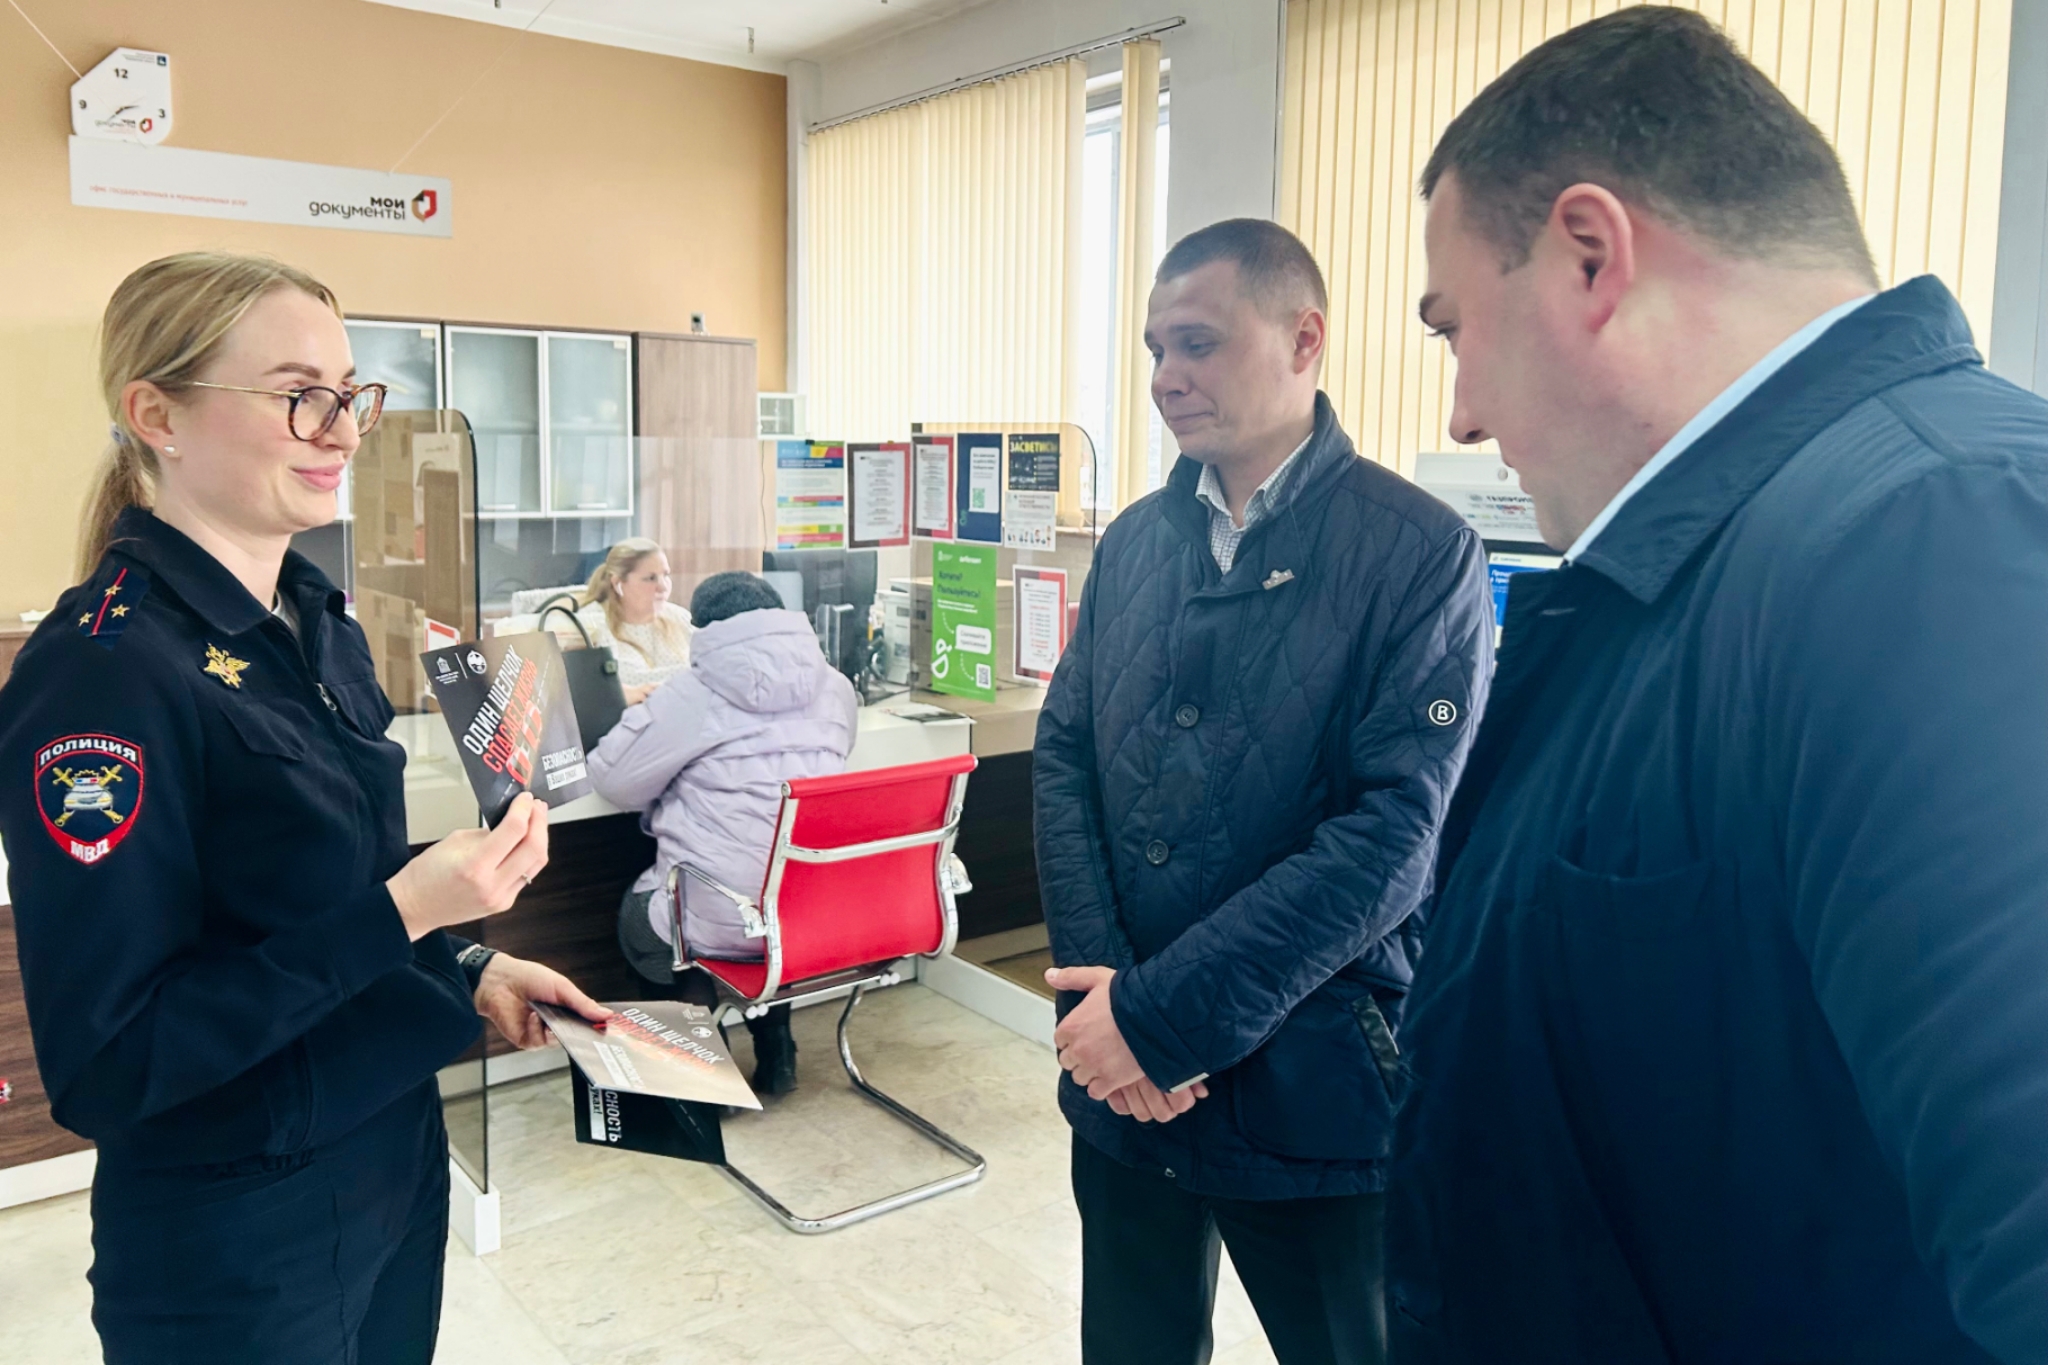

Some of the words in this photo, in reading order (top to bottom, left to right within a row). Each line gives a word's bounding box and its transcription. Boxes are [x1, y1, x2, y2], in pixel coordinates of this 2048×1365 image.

[114, 68, 128, 79] 12
[79, 99, 87, 109] 9
[158, 108, 166, 118] 3
[309, 201, 405, 220] документы
[370, 197, 405, 209] мои
[462, 701, 502, 755] ОДИН
[487, 644, 523, 712] ЩЕЛЧОК
[482, 699, 525, 774] СПАСАЕТ
[513, 657, 538, 707] ЖИЗНЬ
[1437, 705, 1449, 720] B
[40, 739, 137, 766] ПОЛИЦИЯ
[70, 838, 110, 862] МВД
[622, 1007, 667, 1033] ОДИН
[659, 1030, 725, 1064] ЩЕЛЧОК
[590, 1087, 603, 1115] уках!
[605, 1090, 622, 1142] СНОСТЬ
